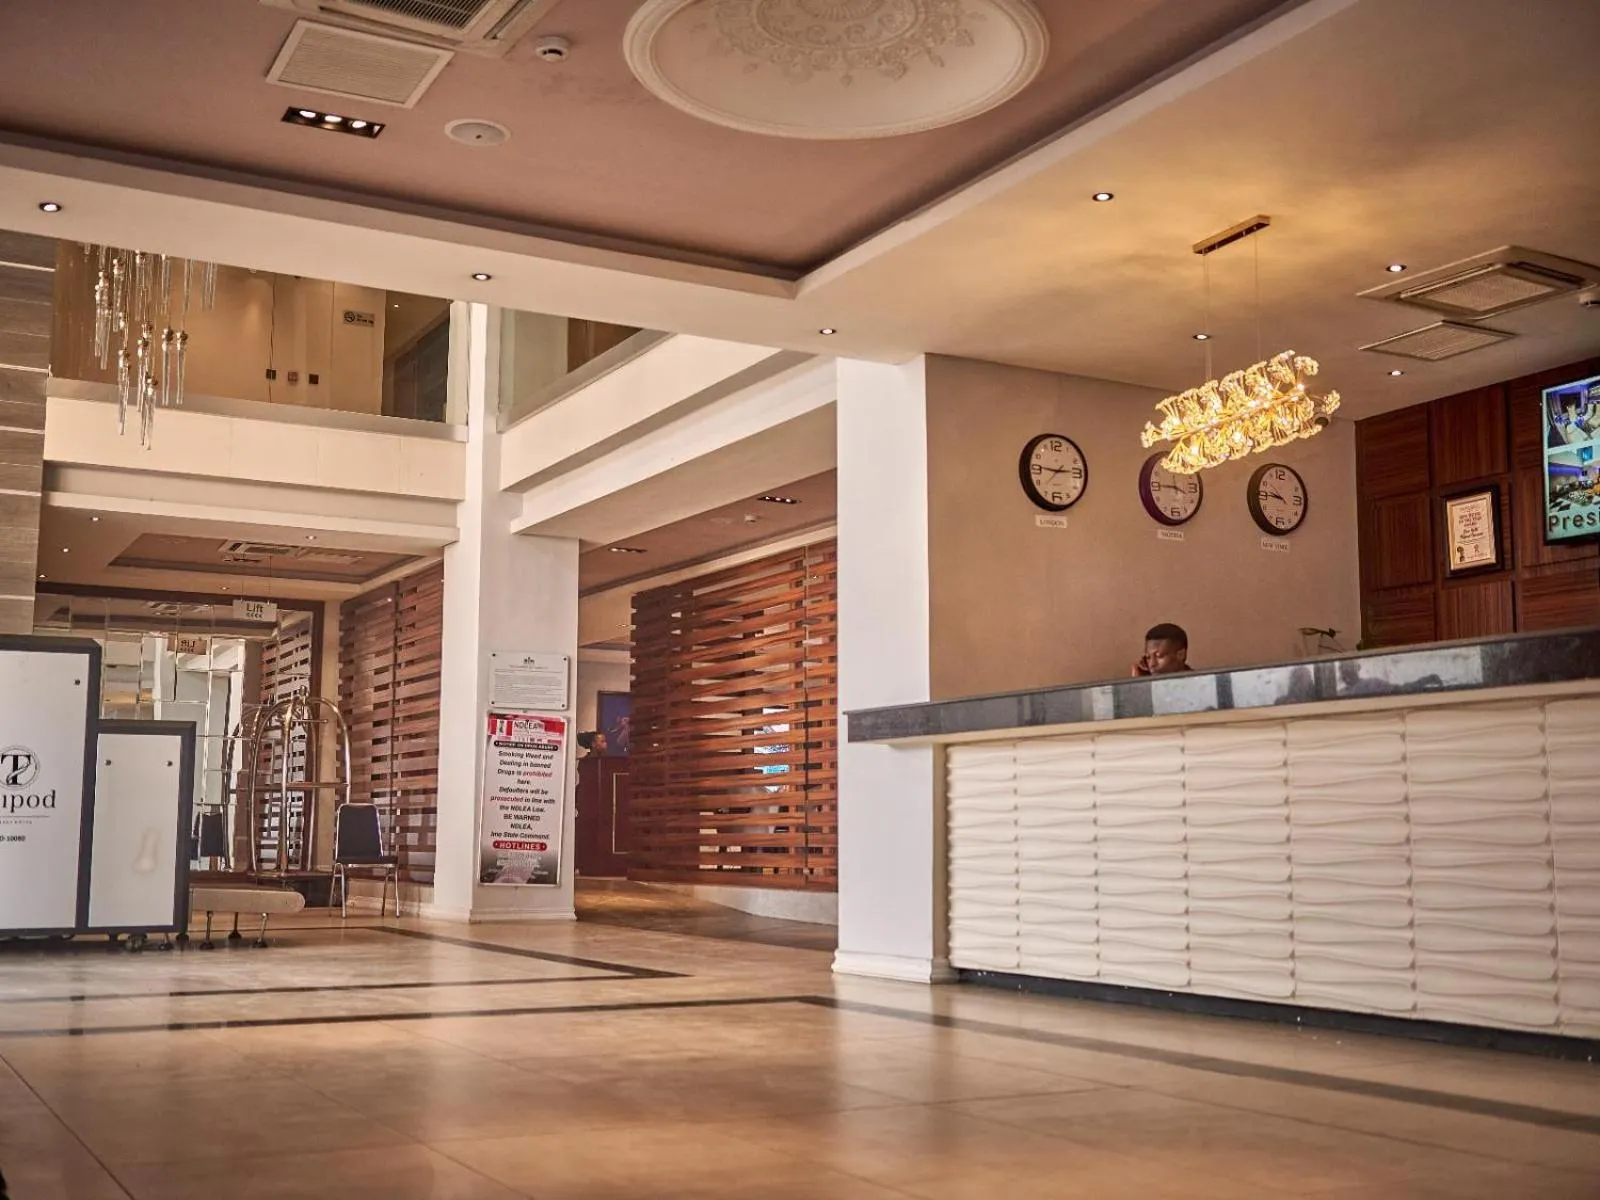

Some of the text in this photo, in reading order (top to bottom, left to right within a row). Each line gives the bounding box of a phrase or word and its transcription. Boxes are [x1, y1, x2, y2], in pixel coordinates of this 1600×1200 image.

[1050, 440, 1062, 452] 12
[1031, 464, 1042, 475] 9
[1072, 467, 1082, 479] 3
[1275, 468, 1286, 480] 12
[1188, 482, 1198, 494] 3
[1170, 507, 1180, 517] 6
[1549, 507, 1600, 532] Presi
[246, 602, 264, 613] Lift
[498, 750, 524, 758] Smoking
[500, 842, 540, 851] HOTLINES
